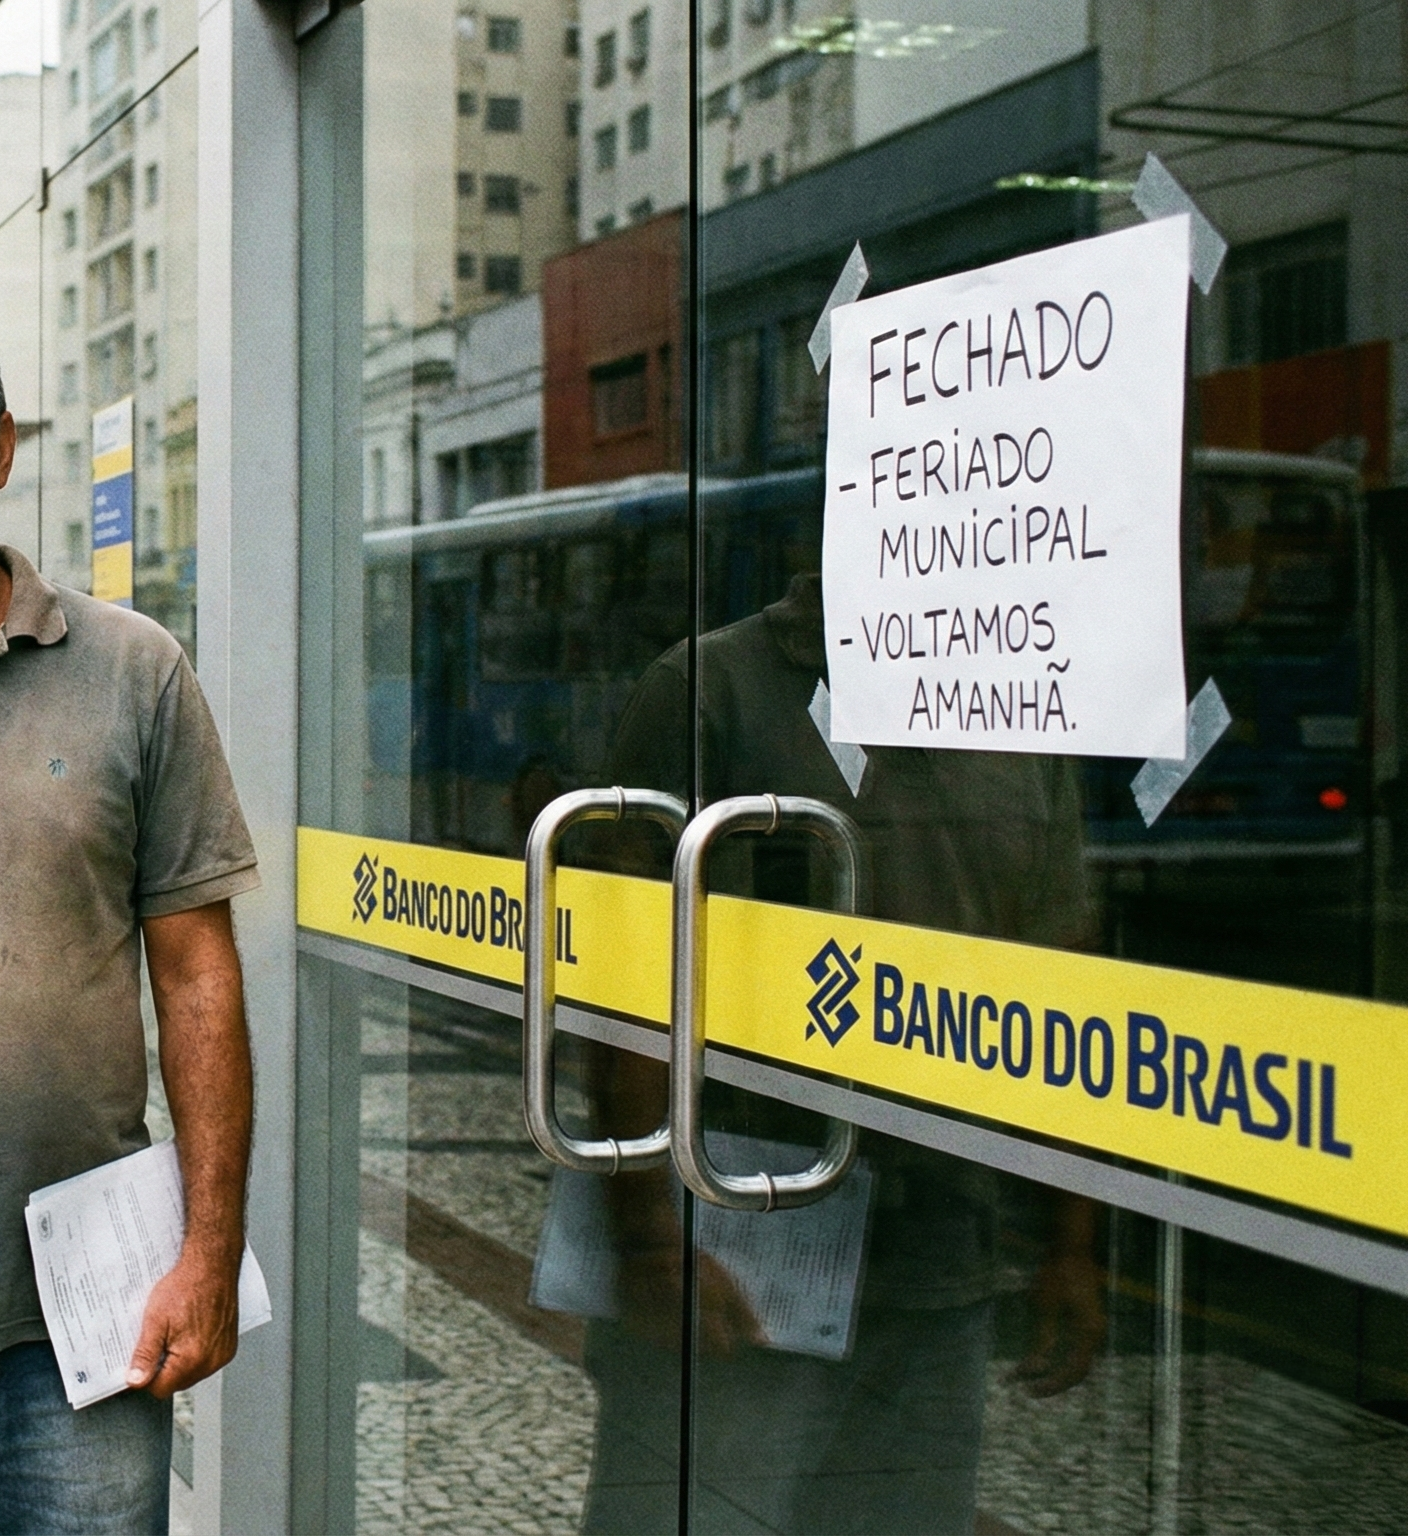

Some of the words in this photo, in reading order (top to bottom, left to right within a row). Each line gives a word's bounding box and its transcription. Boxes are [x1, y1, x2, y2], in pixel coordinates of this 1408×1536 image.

[870, 290, 1113, 418] FECHADO
[879, 504, 1108, 578] MUNICIPAL
[908, 658, 1078, 732] AMANHÃ.
[383, 866, 453, 935] BANCO
[456, 888, 486, 943] DO
[490, 886, 578, 965] BRIL
[873, 961, 1033, 1080] BANCO
[1043, 1008, 1115, 1099] DO
[1126, 1010, 1353, 1160] BRASIL
